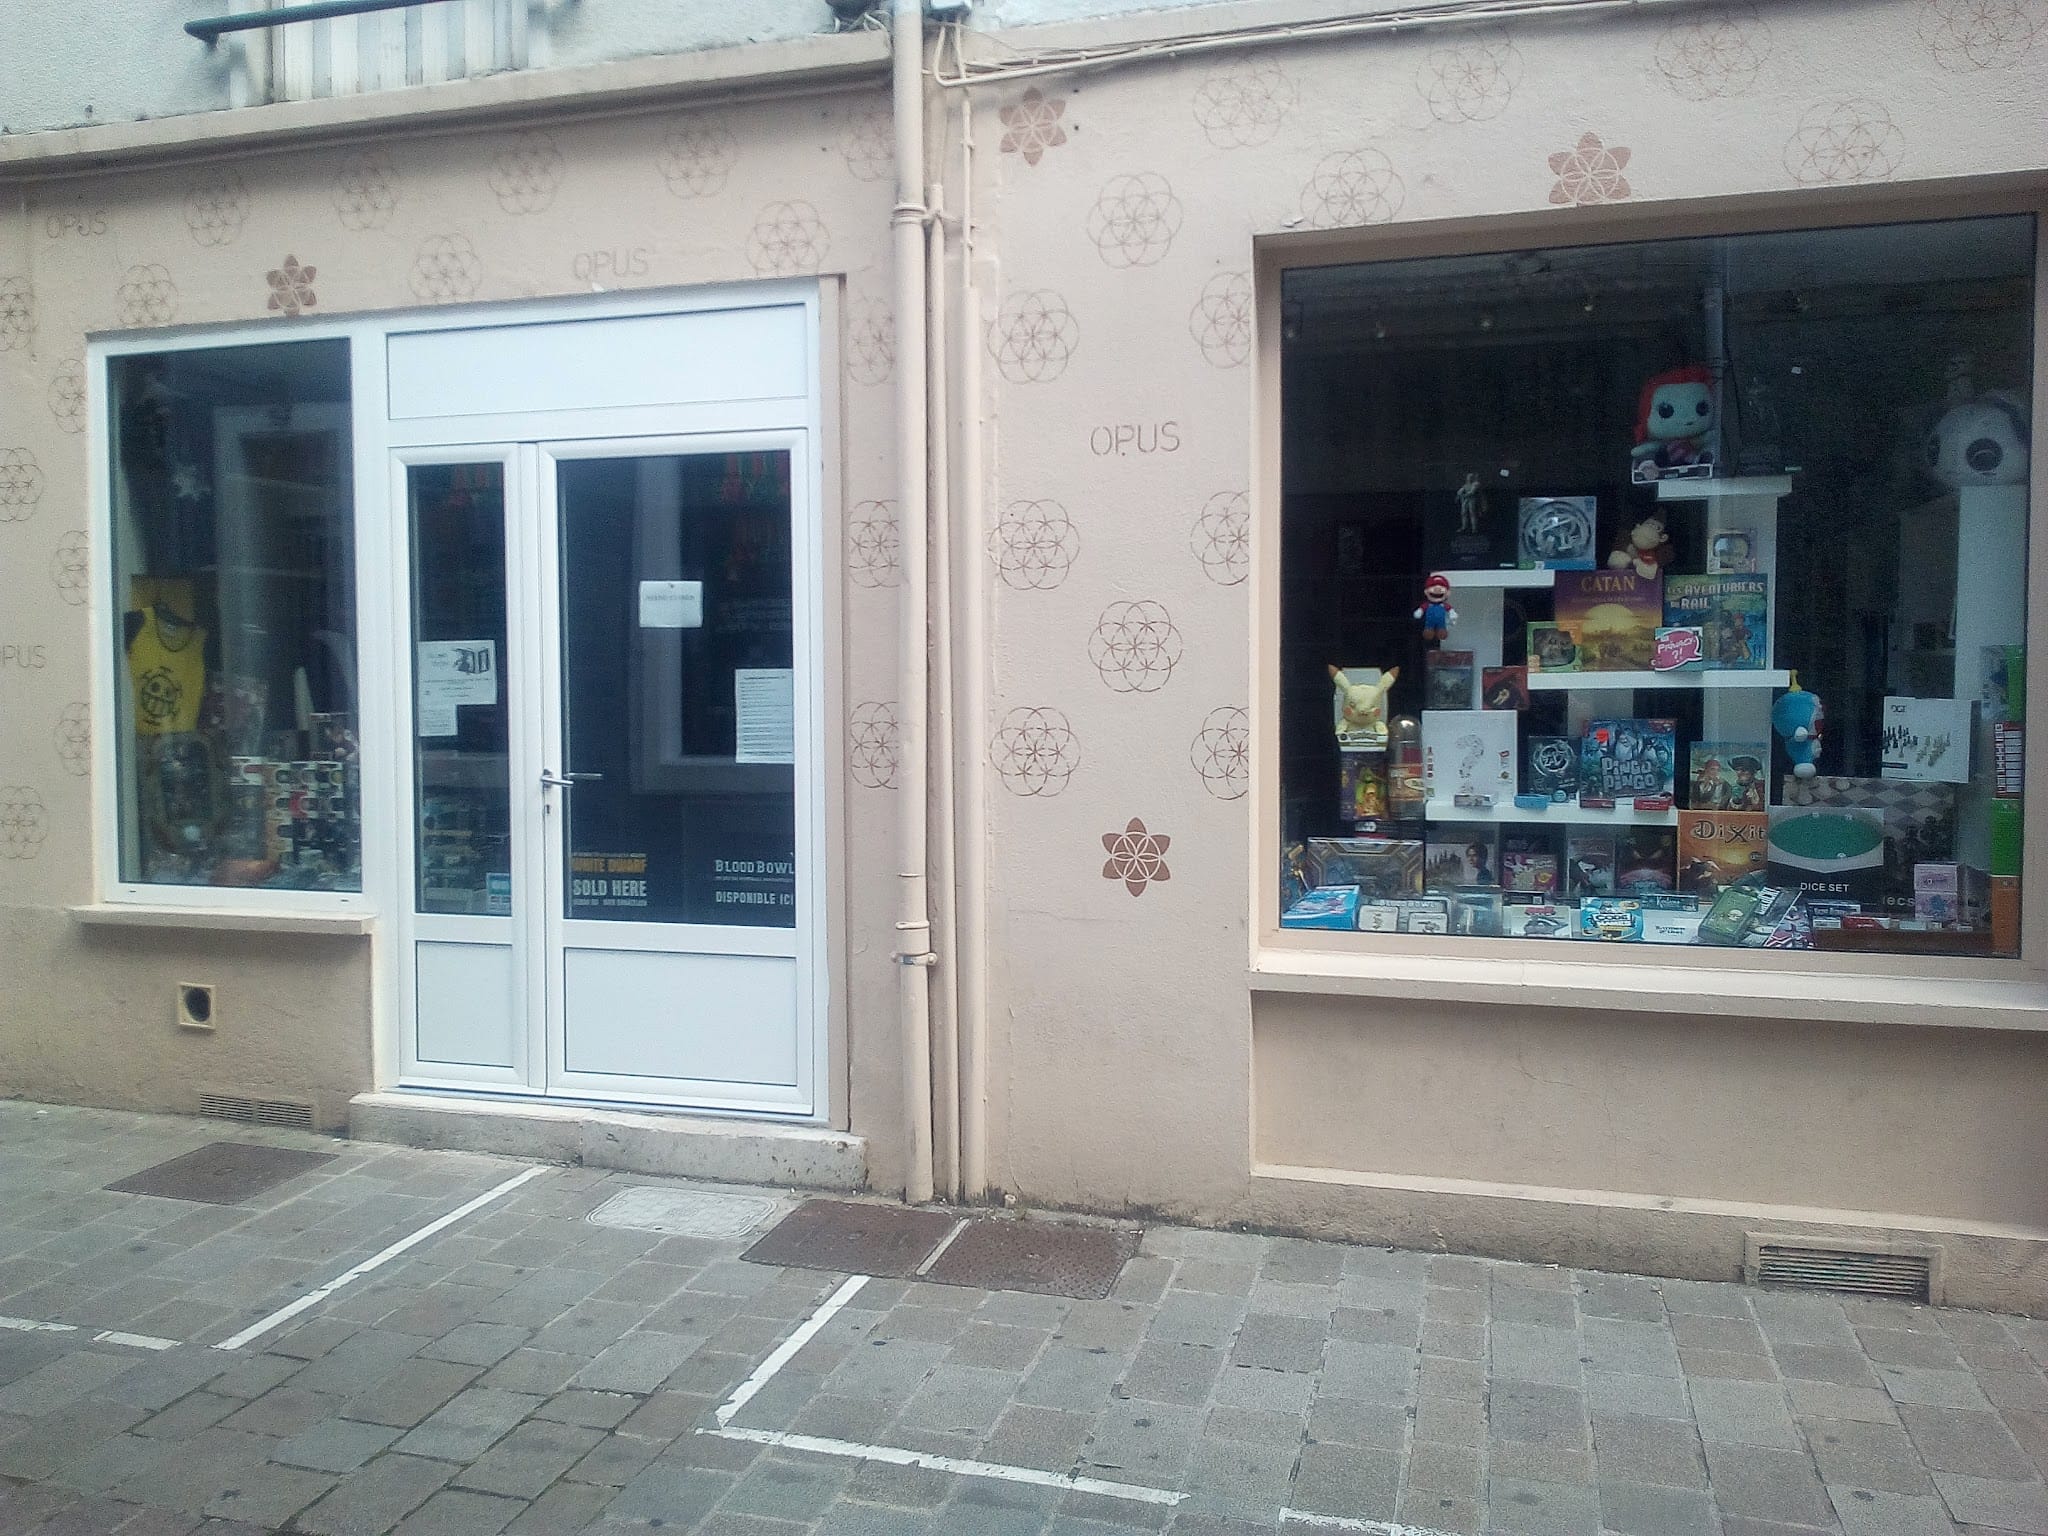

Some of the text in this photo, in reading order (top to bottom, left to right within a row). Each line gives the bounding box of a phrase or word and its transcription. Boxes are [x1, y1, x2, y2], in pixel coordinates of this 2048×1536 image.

[573, 247, 649, 281] OPUS
[1581, 575, 1636, 592] CATAN
[1684, 581, 1765, 596] AVENTURIERS
[1681, 597, 1711, 610] RAIL
[715, 859, 755, 873] BLOOD
[573, 879, 647, 897] SOLD HERE
[1800, 882, 1850, 893] DICE SET
[715, 891, 794, 905] DISPONIBLE ICI
